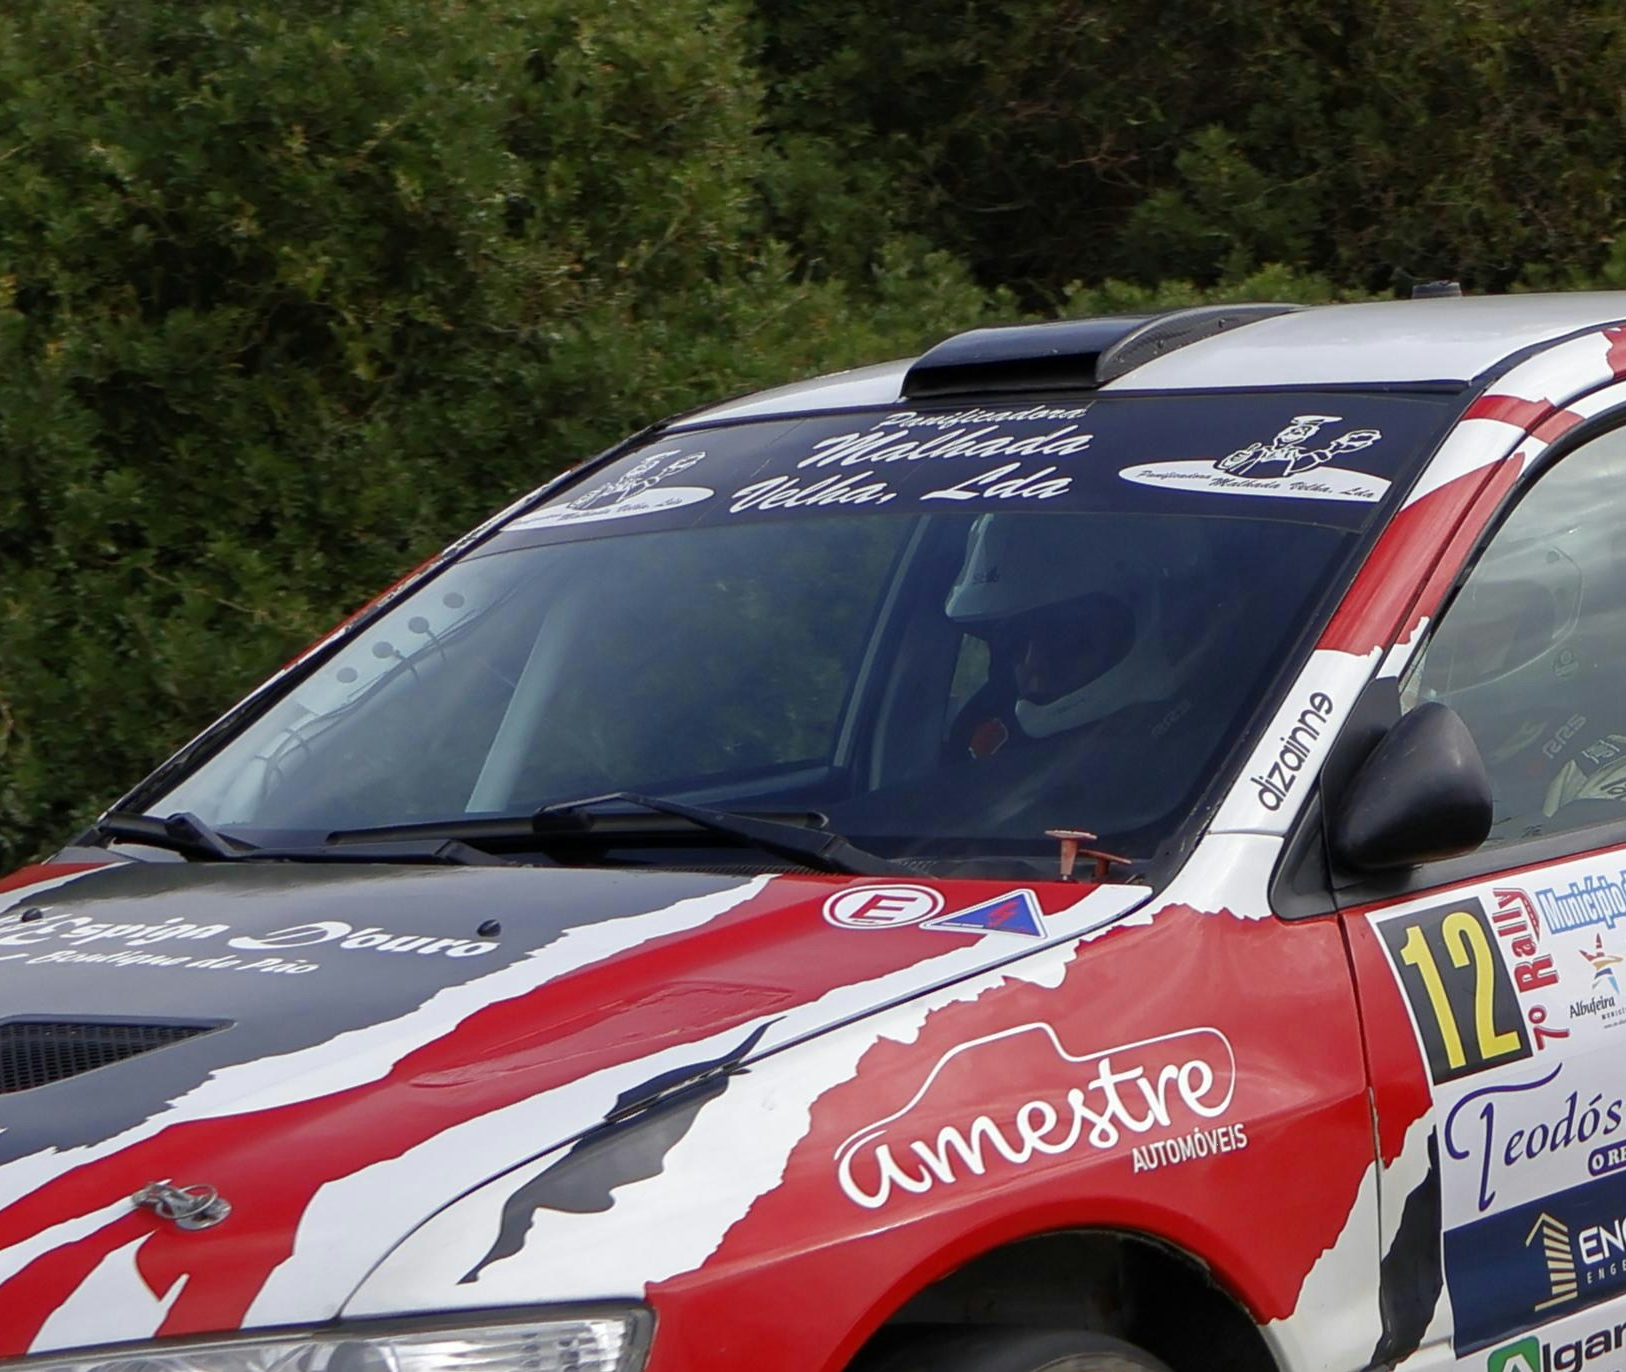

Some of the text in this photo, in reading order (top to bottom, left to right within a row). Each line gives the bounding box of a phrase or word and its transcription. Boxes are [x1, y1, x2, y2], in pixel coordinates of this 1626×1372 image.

[870, 404, 1088, 431] Panificadora
[797, 424, 1095, 469] Malhada
[729, 462, 1073, 513] Velha, Lda
[1252, 691, 1334, 812] dizainne
[848, 893, 919, 922] E
[1535, 875, 1626, 935] Município
[25, 949, 192, 967] Boutique
[1492, 888, 1559, 993] Rally
[1399, 911, 1522, 1070] 12
[1569, 996, 1616, 1019] Albufeira
[835, 1056, 1215, 1209] amestre
[1130, 1122, 1248, 1174] AUTOMÓVEIS
[1591, 1153, 1606, 1172] O
